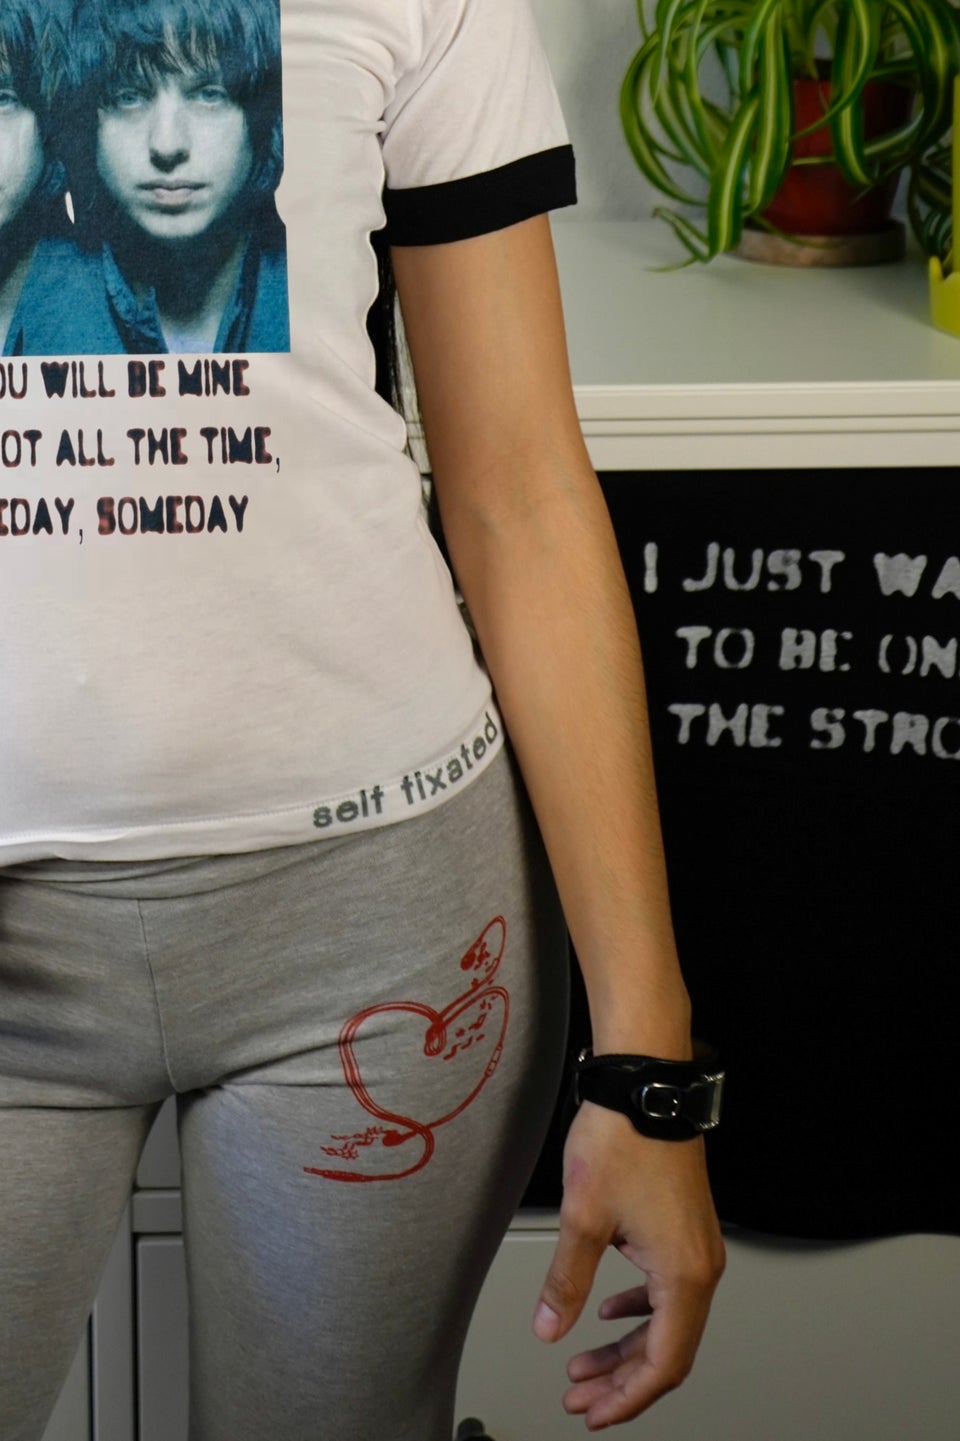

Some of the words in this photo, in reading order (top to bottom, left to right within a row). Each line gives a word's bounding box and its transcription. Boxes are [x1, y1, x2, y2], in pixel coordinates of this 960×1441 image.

[41, 360, 116, 399] WILL
[127, 360, 166, 398] BE
[177, 359, 250, 397] MINE
[55, 428, 115, 467] ALL
[126, 427, 188, 466] THE
[199, 426, 281, 473] TIME,
[96, 494, 249, 535] SOMEDAY
[644, 542, 658, 593] I
[682, 541, 846, 593] JUST
[675, 625, 755, 669] TO
[667, 702, 785, 748] THE
[312, 785, 385, 828] self
[400, 711, 499, 806] fixated
